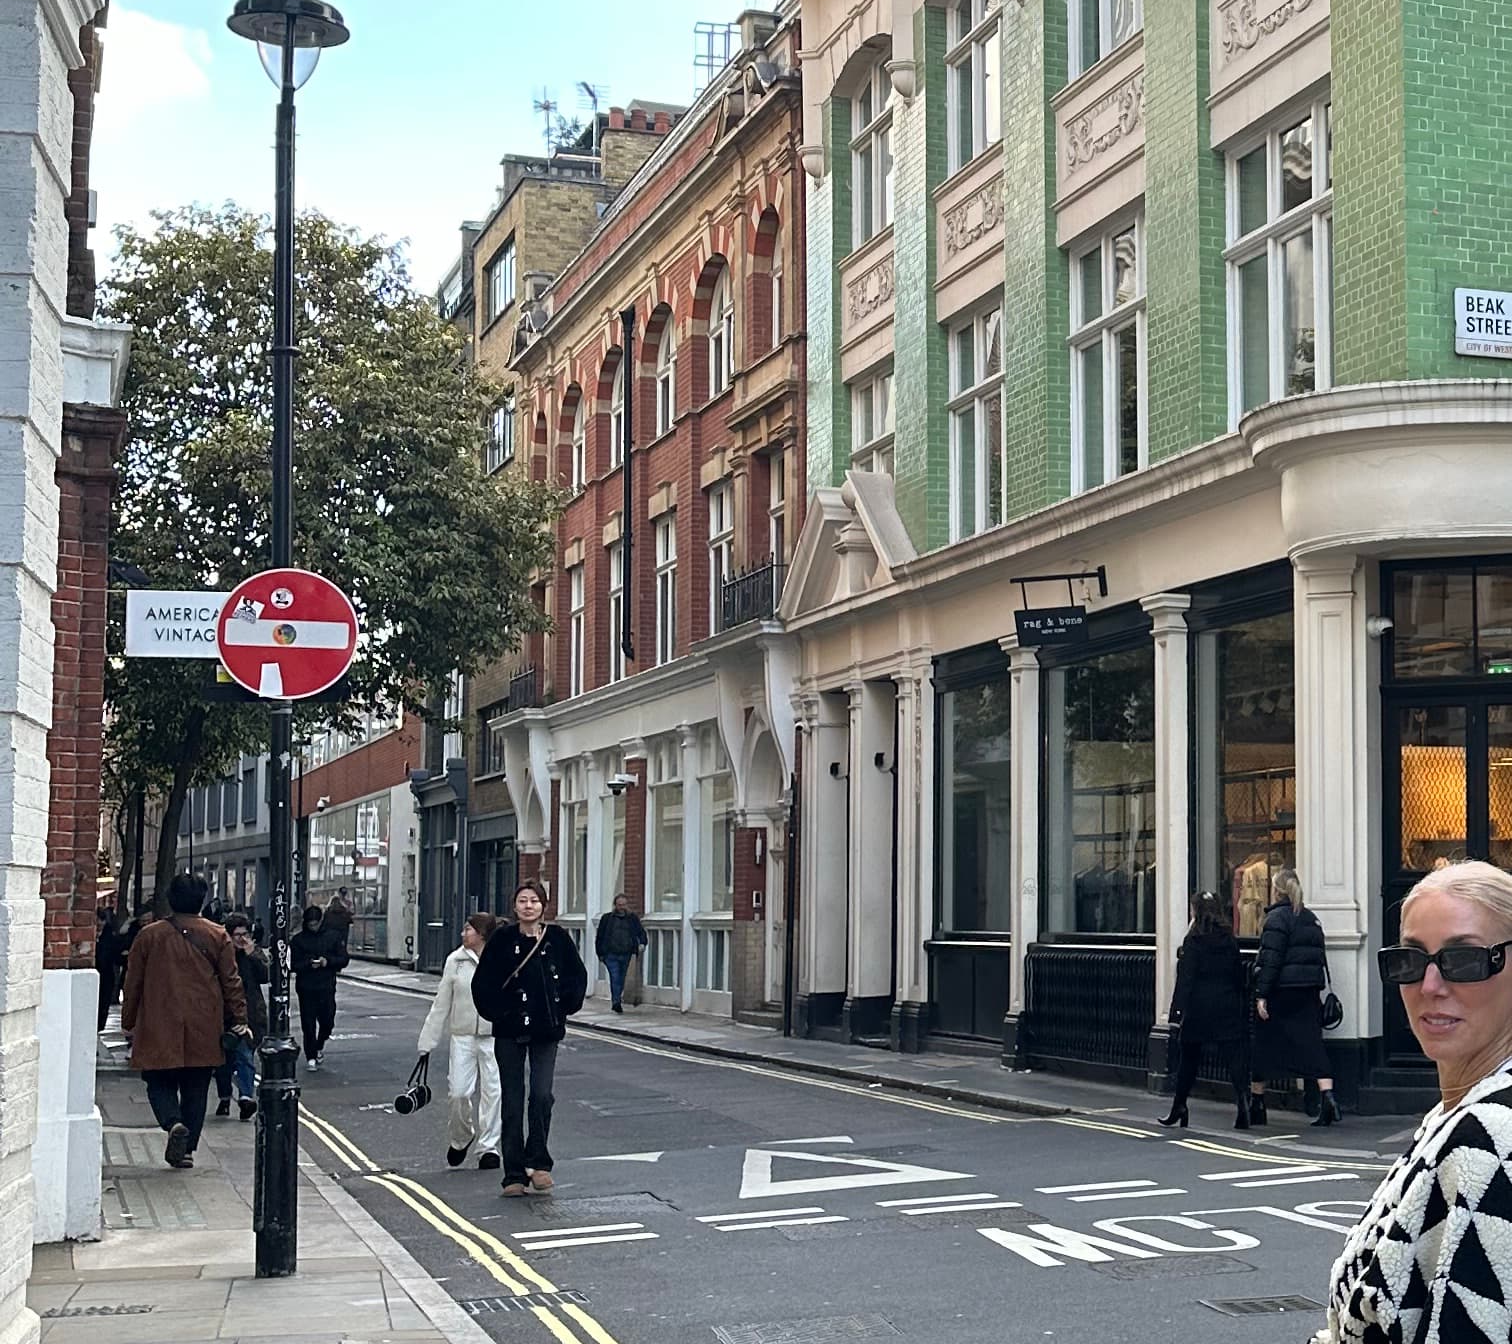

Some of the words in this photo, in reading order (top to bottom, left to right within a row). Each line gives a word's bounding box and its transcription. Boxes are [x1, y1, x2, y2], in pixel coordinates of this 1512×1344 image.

[1466, 296, 1505, 315] BEAK
[1466, 343, 1482, 351] CITY
[1483, 344, 1492, 353] OF
[145, 607, 220, 621] AMERICA
[1023, 620, 1042, 629] rag
[1046, 617, 1054, 627] &
[1058, 617, 1083, 626] bone
[153, 627, 216, 642] VINTAG
